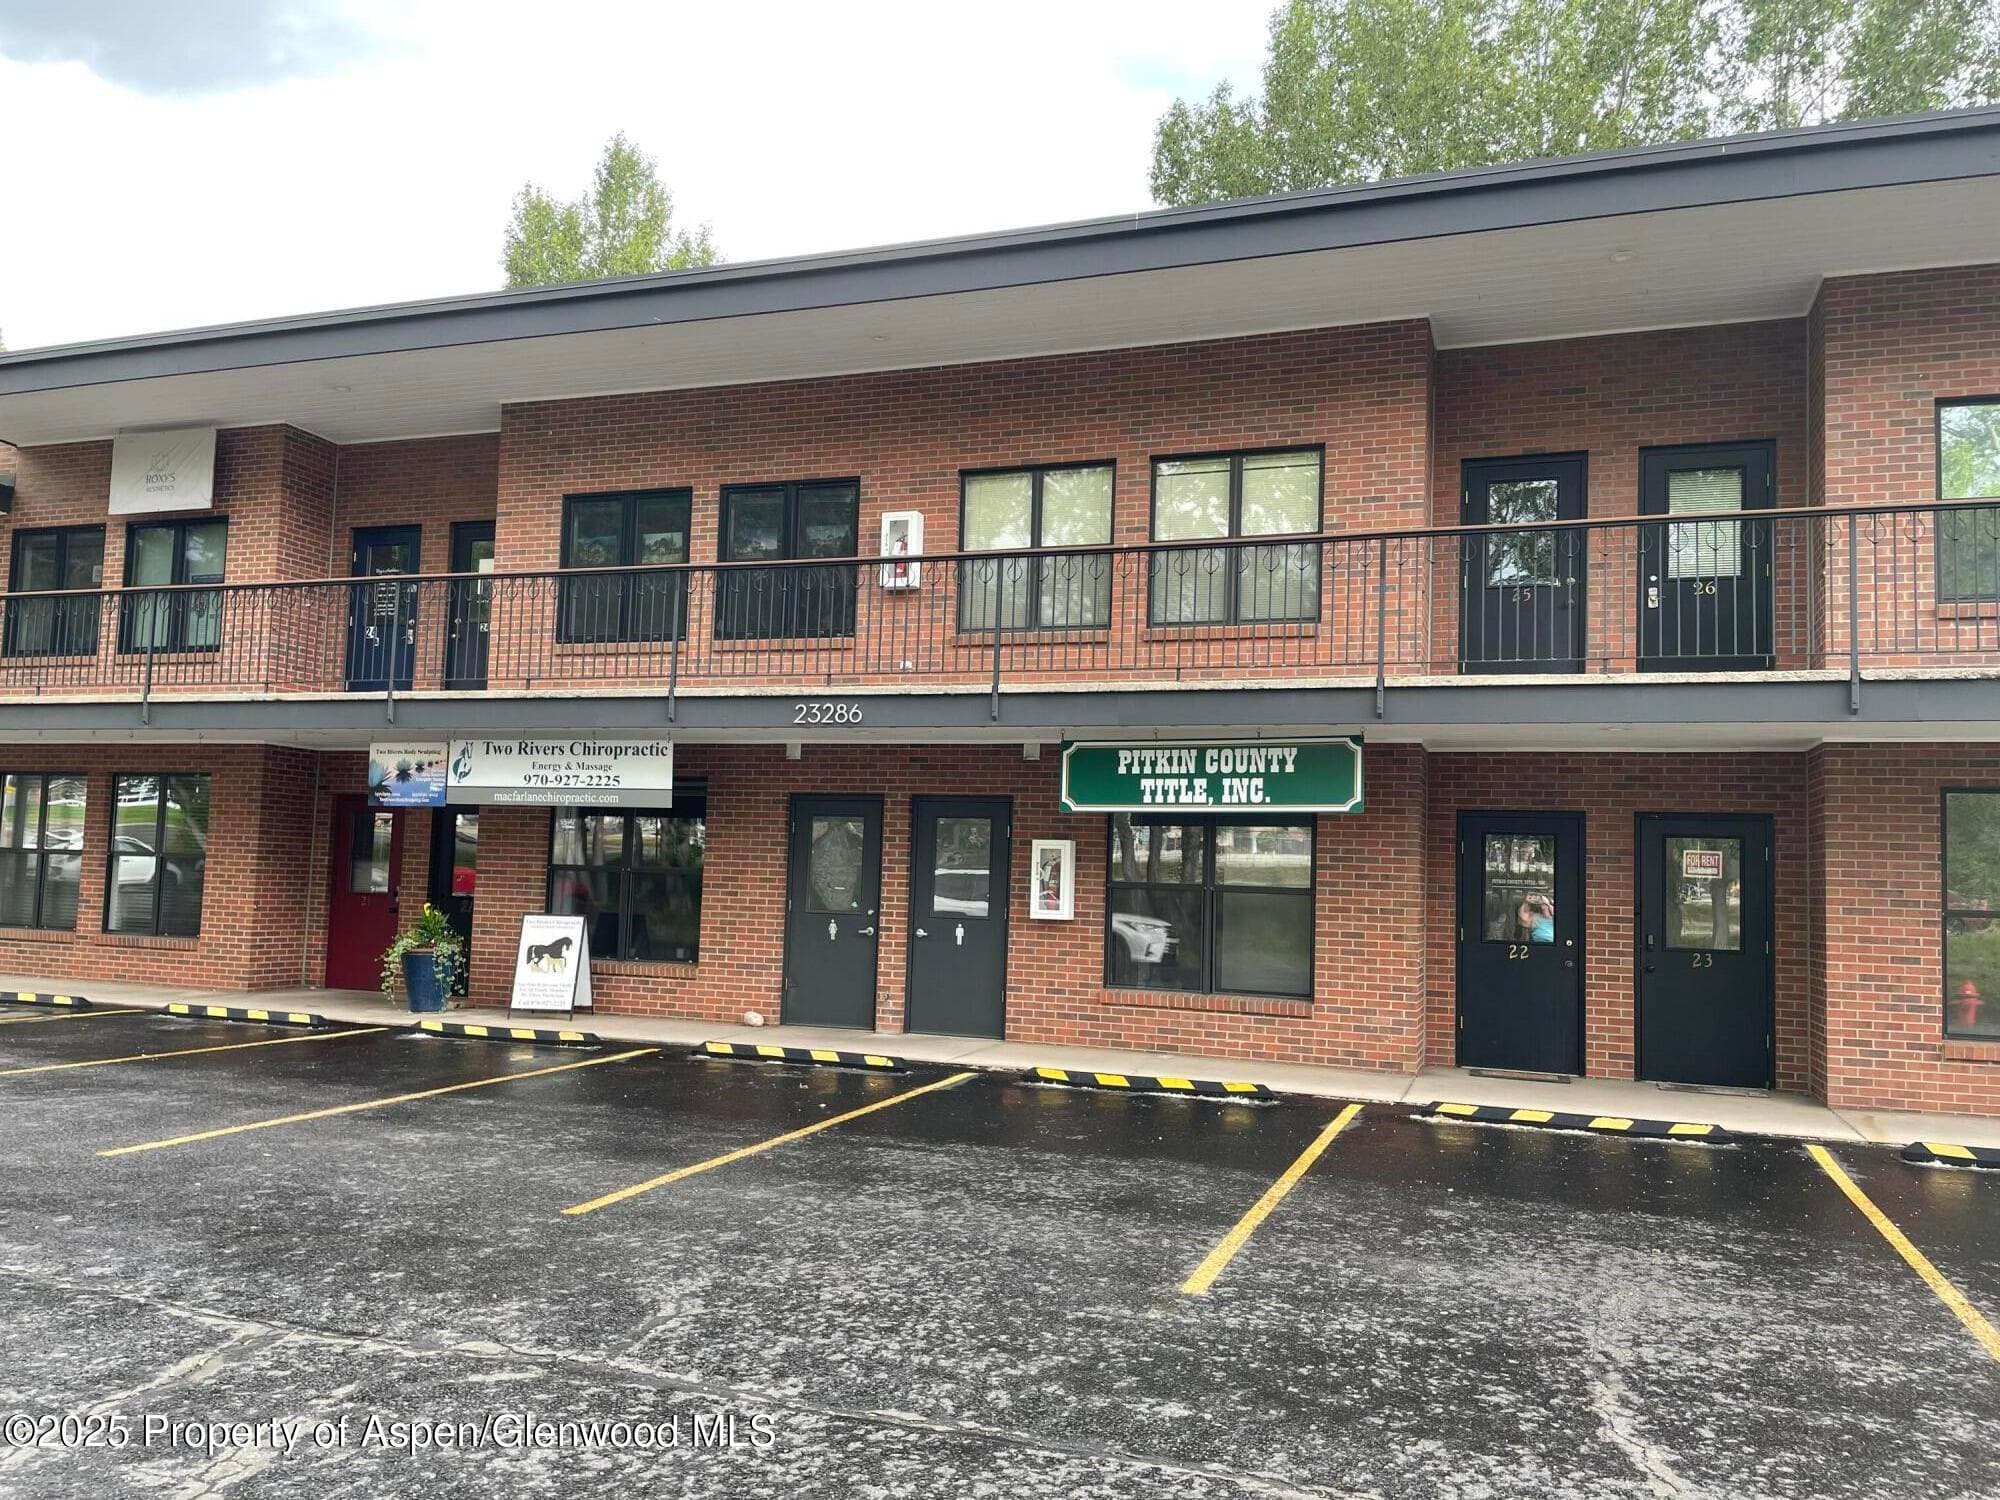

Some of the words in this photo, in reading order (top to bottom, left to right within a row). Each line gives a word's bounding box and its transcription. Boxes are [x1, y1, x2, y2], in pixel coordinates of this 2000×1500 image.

[1512, 588, 1531, 602] 25
[1693, 580, 1716, 595] 26
[793, 703, 863, 724] 23286
[482, 741, 513, 756] Two
[517, 741, 565, 756] Rivers
[569, 741, 669, 760] Chiropractic
[531, 761, 562, 772] Energy
[565, 762, 572, 770] &
[575, 762, 614, 772] Massage
[1117, 749, 1198, 774] PITKIN
[1204, 747, 1298, 774] COUNTY
[523, 774, 621, 787] 970-927-2225
[494, 792, 619, 806] macfarlanechiropractic.com
[1140, 778, 1214, 806] TITLE,
[1221, 777, 1271, 804] INC.
[1686, 854, 1700, 867] FOR
[1701, 855, 1719, 867] RENT
[1509, 944, 1529, 959] 22
[1692, 952, 1712, 968] 23
